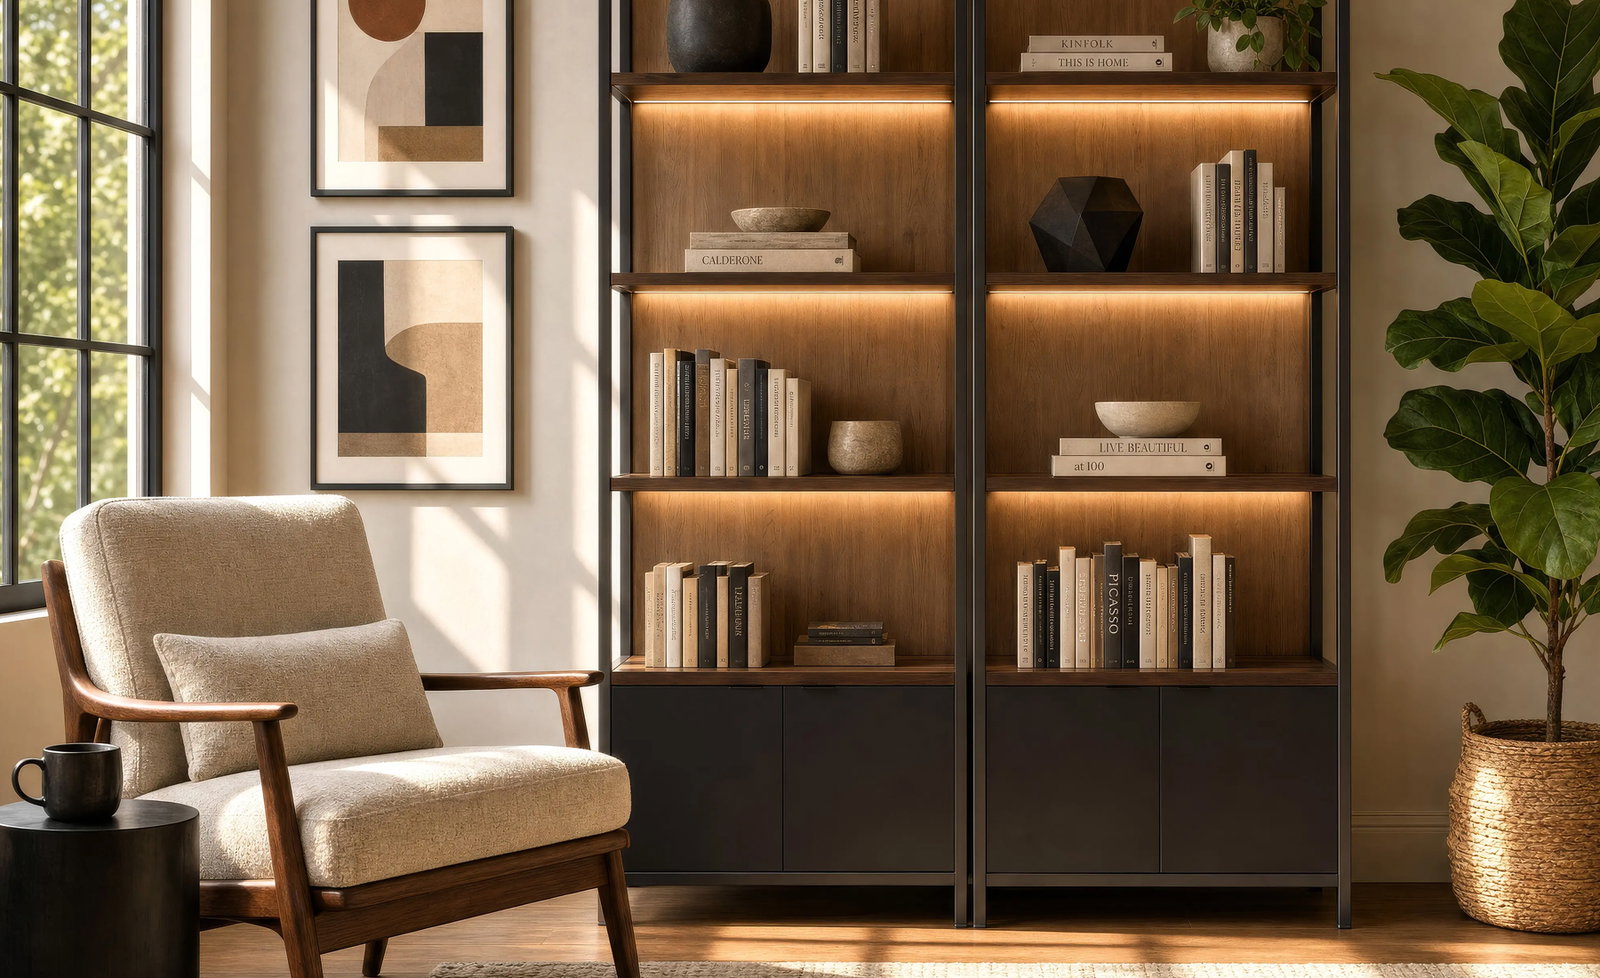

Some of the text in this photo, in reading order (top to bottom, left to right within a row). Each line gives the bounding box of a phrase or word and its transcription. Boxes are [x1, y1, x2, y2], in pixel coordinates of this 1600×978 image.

[1061, 39, 1113, 48] KINFOLK
[1058, 58, 1129, 67] THIS IS HOME
[702, 255, 763, 265] CALDERONE
[1099, 443, 1188, 453] LIVE BEAUTIFUL
[1074, 461, 1105, 471] at 100
[1108, 573, 1119, 634] PICASSO
